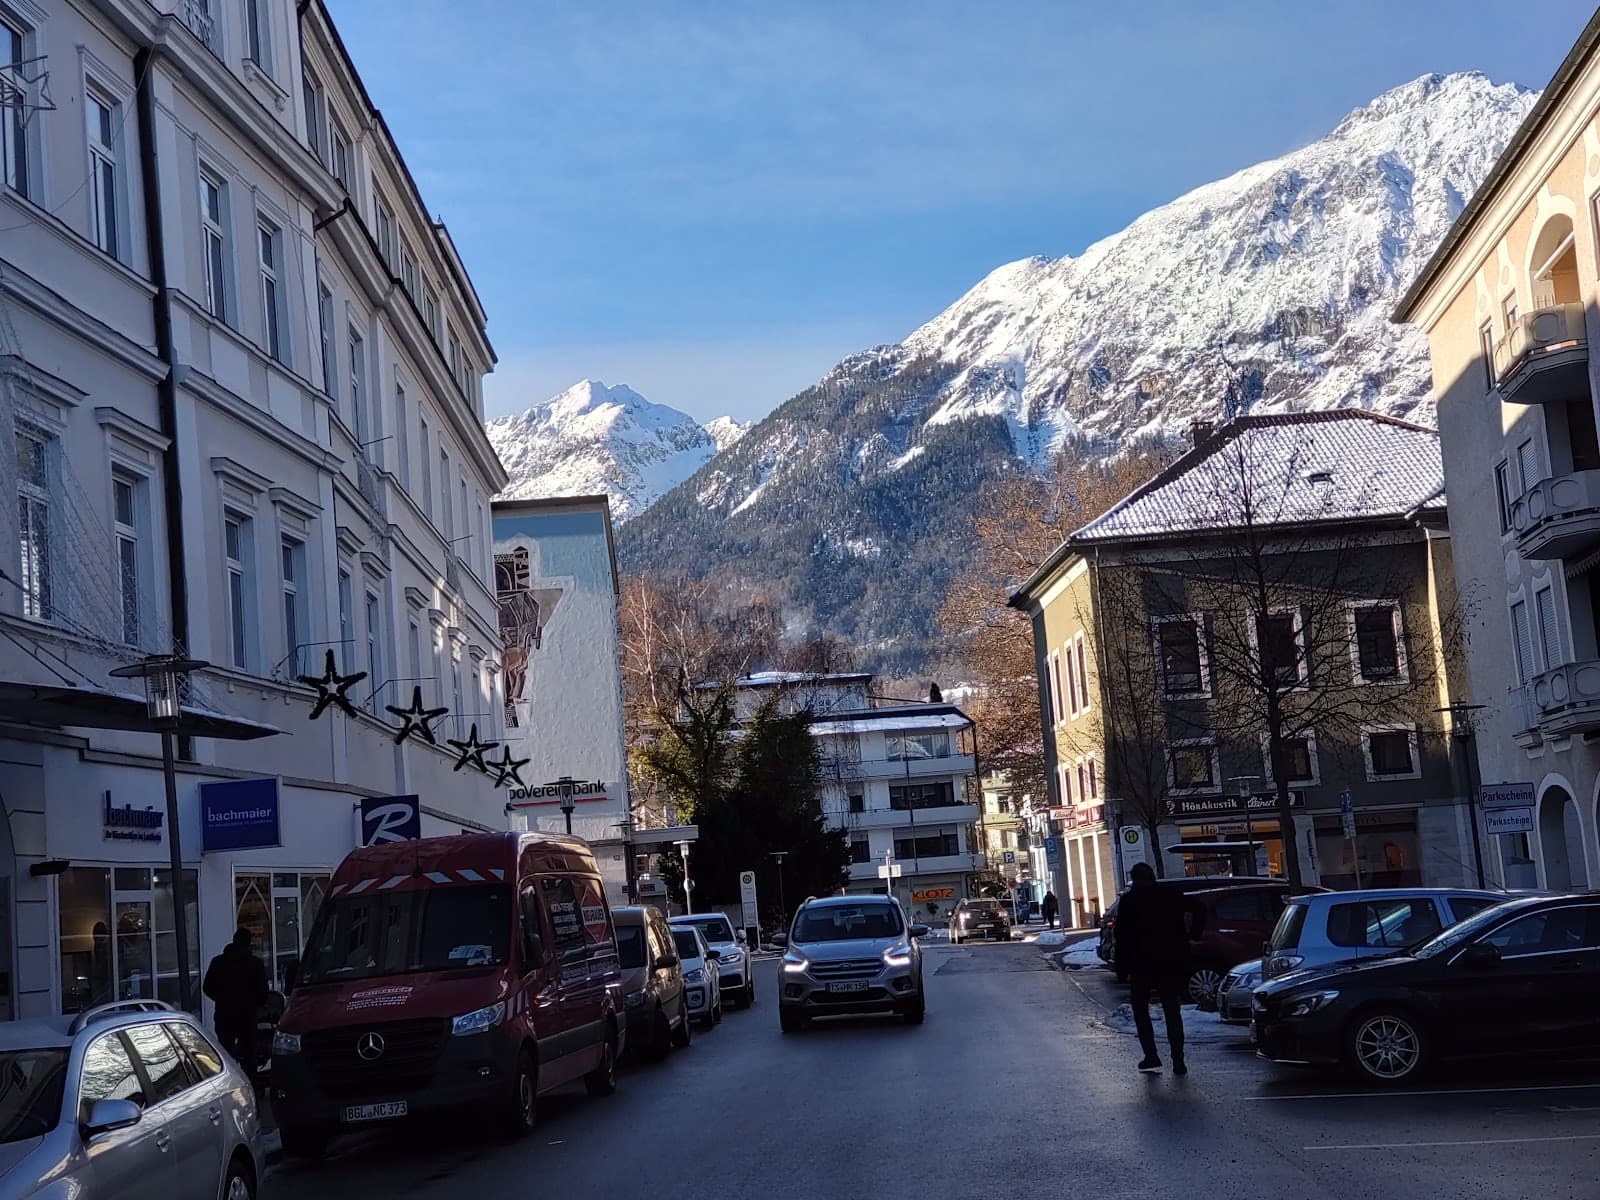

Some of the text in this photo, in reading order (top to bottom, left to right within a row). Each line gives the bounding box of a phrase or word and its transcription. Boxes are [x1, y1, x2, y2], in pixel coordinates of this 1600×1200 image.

[1482, 790, 1532, 801] Parkscheine
[208, 807, 272, 822] bachmaier
[1488, 816, 1529, 827] Parkscheine
[1005, 853, 1013, 863] P
[912, 888, 954, 898] KLOTZ
[348, 1107, 366, 1120] BGL
[388, 1103, 406, 1115] 373
